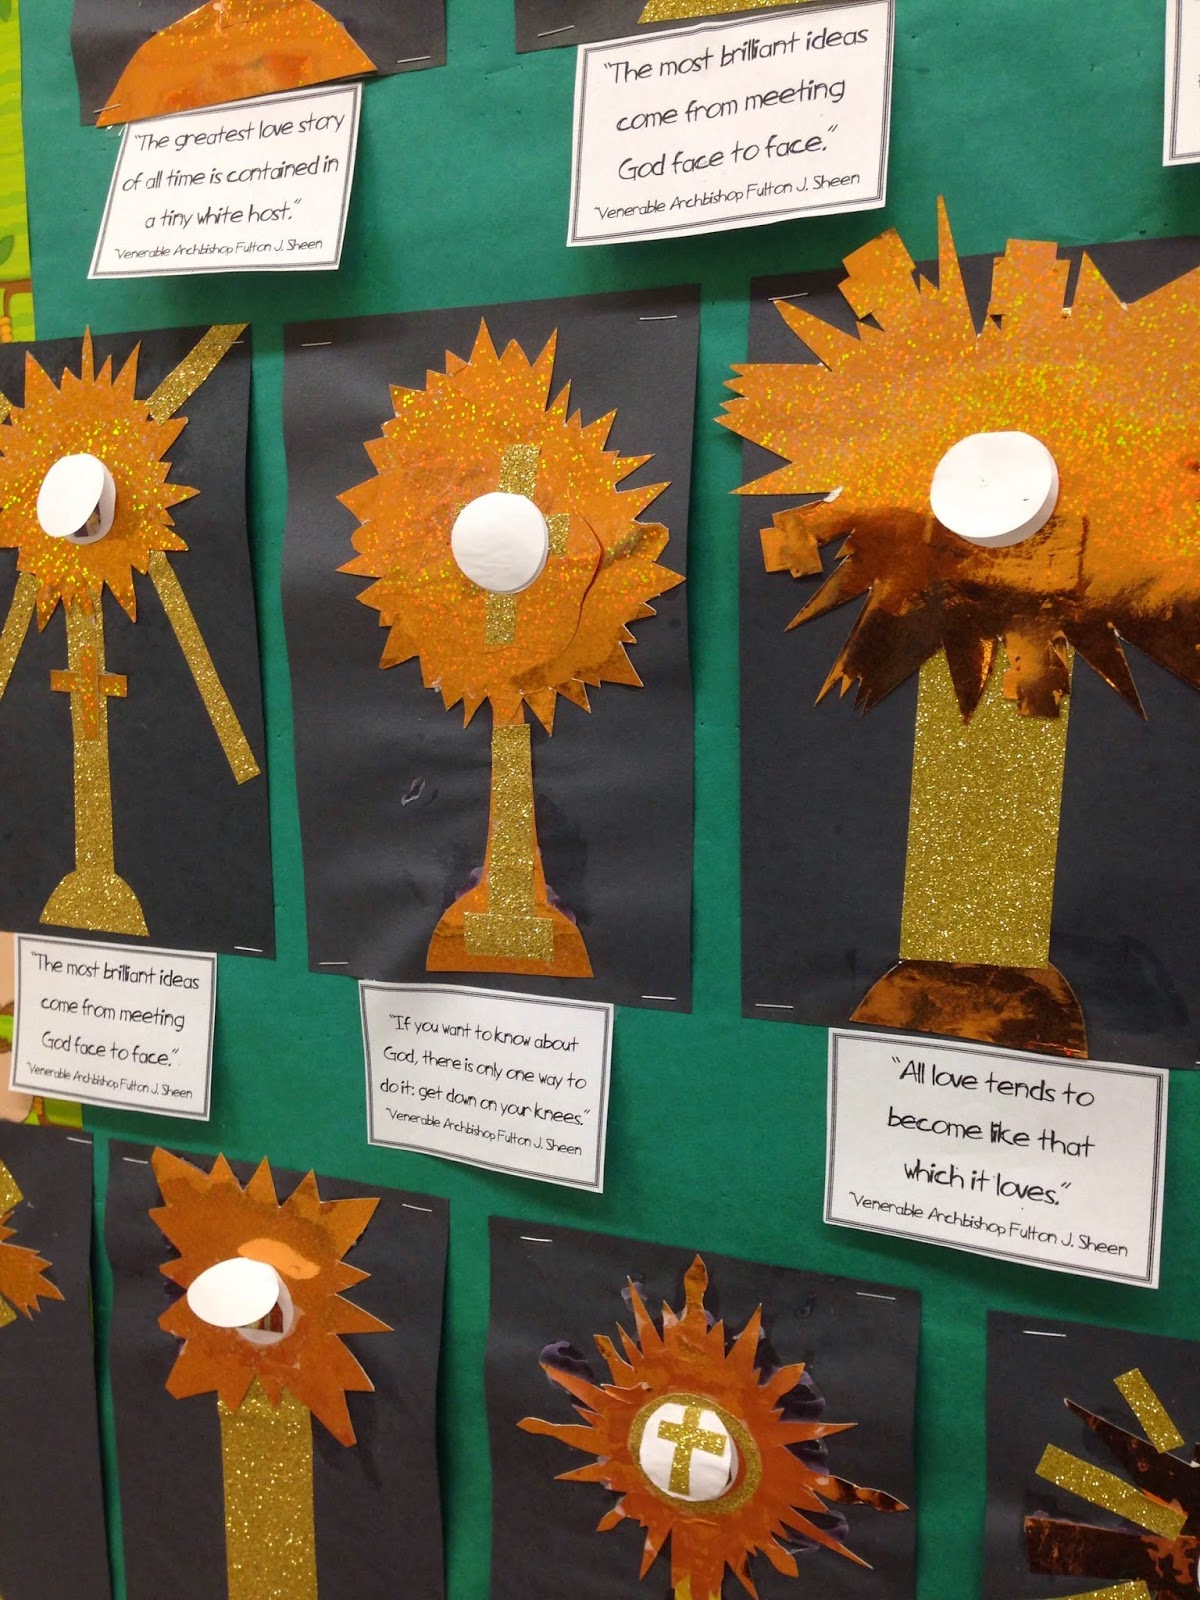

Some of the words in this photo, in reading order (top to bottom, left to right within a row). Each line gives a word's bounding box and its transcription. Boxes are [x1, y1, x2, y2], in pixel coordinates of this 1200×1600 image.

[659, 47, 714, 76] most
[720, 32, 800, 67] brilliant
[806, 28, 868, 50] ideas
[616, 109, 678, 131] come
[685, 99, 737, 122] from
[745, 79, 845, 111] meeting
[175, 122, 254, 151] greatest
[259, 119, 293, 139] love
[298, 113, 345, 133] story
[122, 173, 143, 191] of
[145, 171, 162, 189] all
[166, 169, 205, 187] time
[209, 167, 223, 184] is
[226, 156, 320, 182] contained
[323, 155, 339, 173] in
[618, 154, 665, 181] God
[673, 151, 724, 173] face
[730, 141, 759, 163] to
[669, 190, 744, 210] Archbishop
[747, 182, 792, 199] Fulton
[796, 176, 809, 192] J.
[813, 173, 860, 190] Sheen
[145, 215, 155, 228] a
[160, 210, 192, 229] tiny
[197, 205, 244, 225] white
[173, 244, 233, 256] Archbishop
[236, 242, 272, 254] Fulton
[274, 241, 284, 252] J.
[287, 239, 322, 250] Sheen
[67, 961, 100, 978] most
[104, 962, 156, 984] brilliant
[160, 970, 200, 989] ideas
[41, 997, 78, 1013] come
[82, 999, 115, 1020] from
[120, 1007, 185, 1032] meeting
[42, 1031, 71, 1051] God
[74, 1036, 106, 1056] face
[110, 1042, 129, 1061] to
[414, 1020, 439, 1033] you
[441, 1023, 472, 1037] want
[475, 1024, 492, 1041] to
[494, 1026, 531, 1047] know
[534, 1033, 579, 1052] about
[73, 1071, 119, 1090] Archbishop
[120, 1079, 149, 1093] Fulton
[151, 1082, 159, 1095] J.
[162, 1084, 193, 1099] Sheen
[383, 1046, 419, 1066] God,
[422, 1050, 462, 1070] there
[464, 1058, 474, 1072] is
[476, 1063, 503, 1080] only
[506, 1068, 535, 1082] one
[538, 1074, 563, 1089] way
[567, 1073, 587, 1089] to
[931, 1063, 978, 1090] love
[985, 1071, 1056, 1102] tends
[1062, 1082, 1095, 1107] to
[380, 1078, 398, 1093] do
[400, 1081, 415, 1096] it:
[418, 1085, 443, 1101] get
[446, 1088, 477, 1107] down
[480, 1097, 497, 1111] on
[501, 1101, 532, 1117] your
[443, 1118, 496, 1142] Archbishop
[497, 1130, 532, 1148] Fulton
[533, 1138, 543, 1149] J.
[546, 1138, 582, 1156] Sheen
[887, 1106, 983, 1140] become
[990, 1121, 1031, 1147] like
[1037, 1128, 1096, 1157] that
[904, 1159, 964, 1189] which
[971, 1169, 990, 1191] it
[927, 1207, 1007, 1237] Archbishop
[1009, 1222, 1057, 1245] Fulton
[1061, 1233, 1074, 1248] J.
[1078, 1234, 1129, 1257] Sheen
